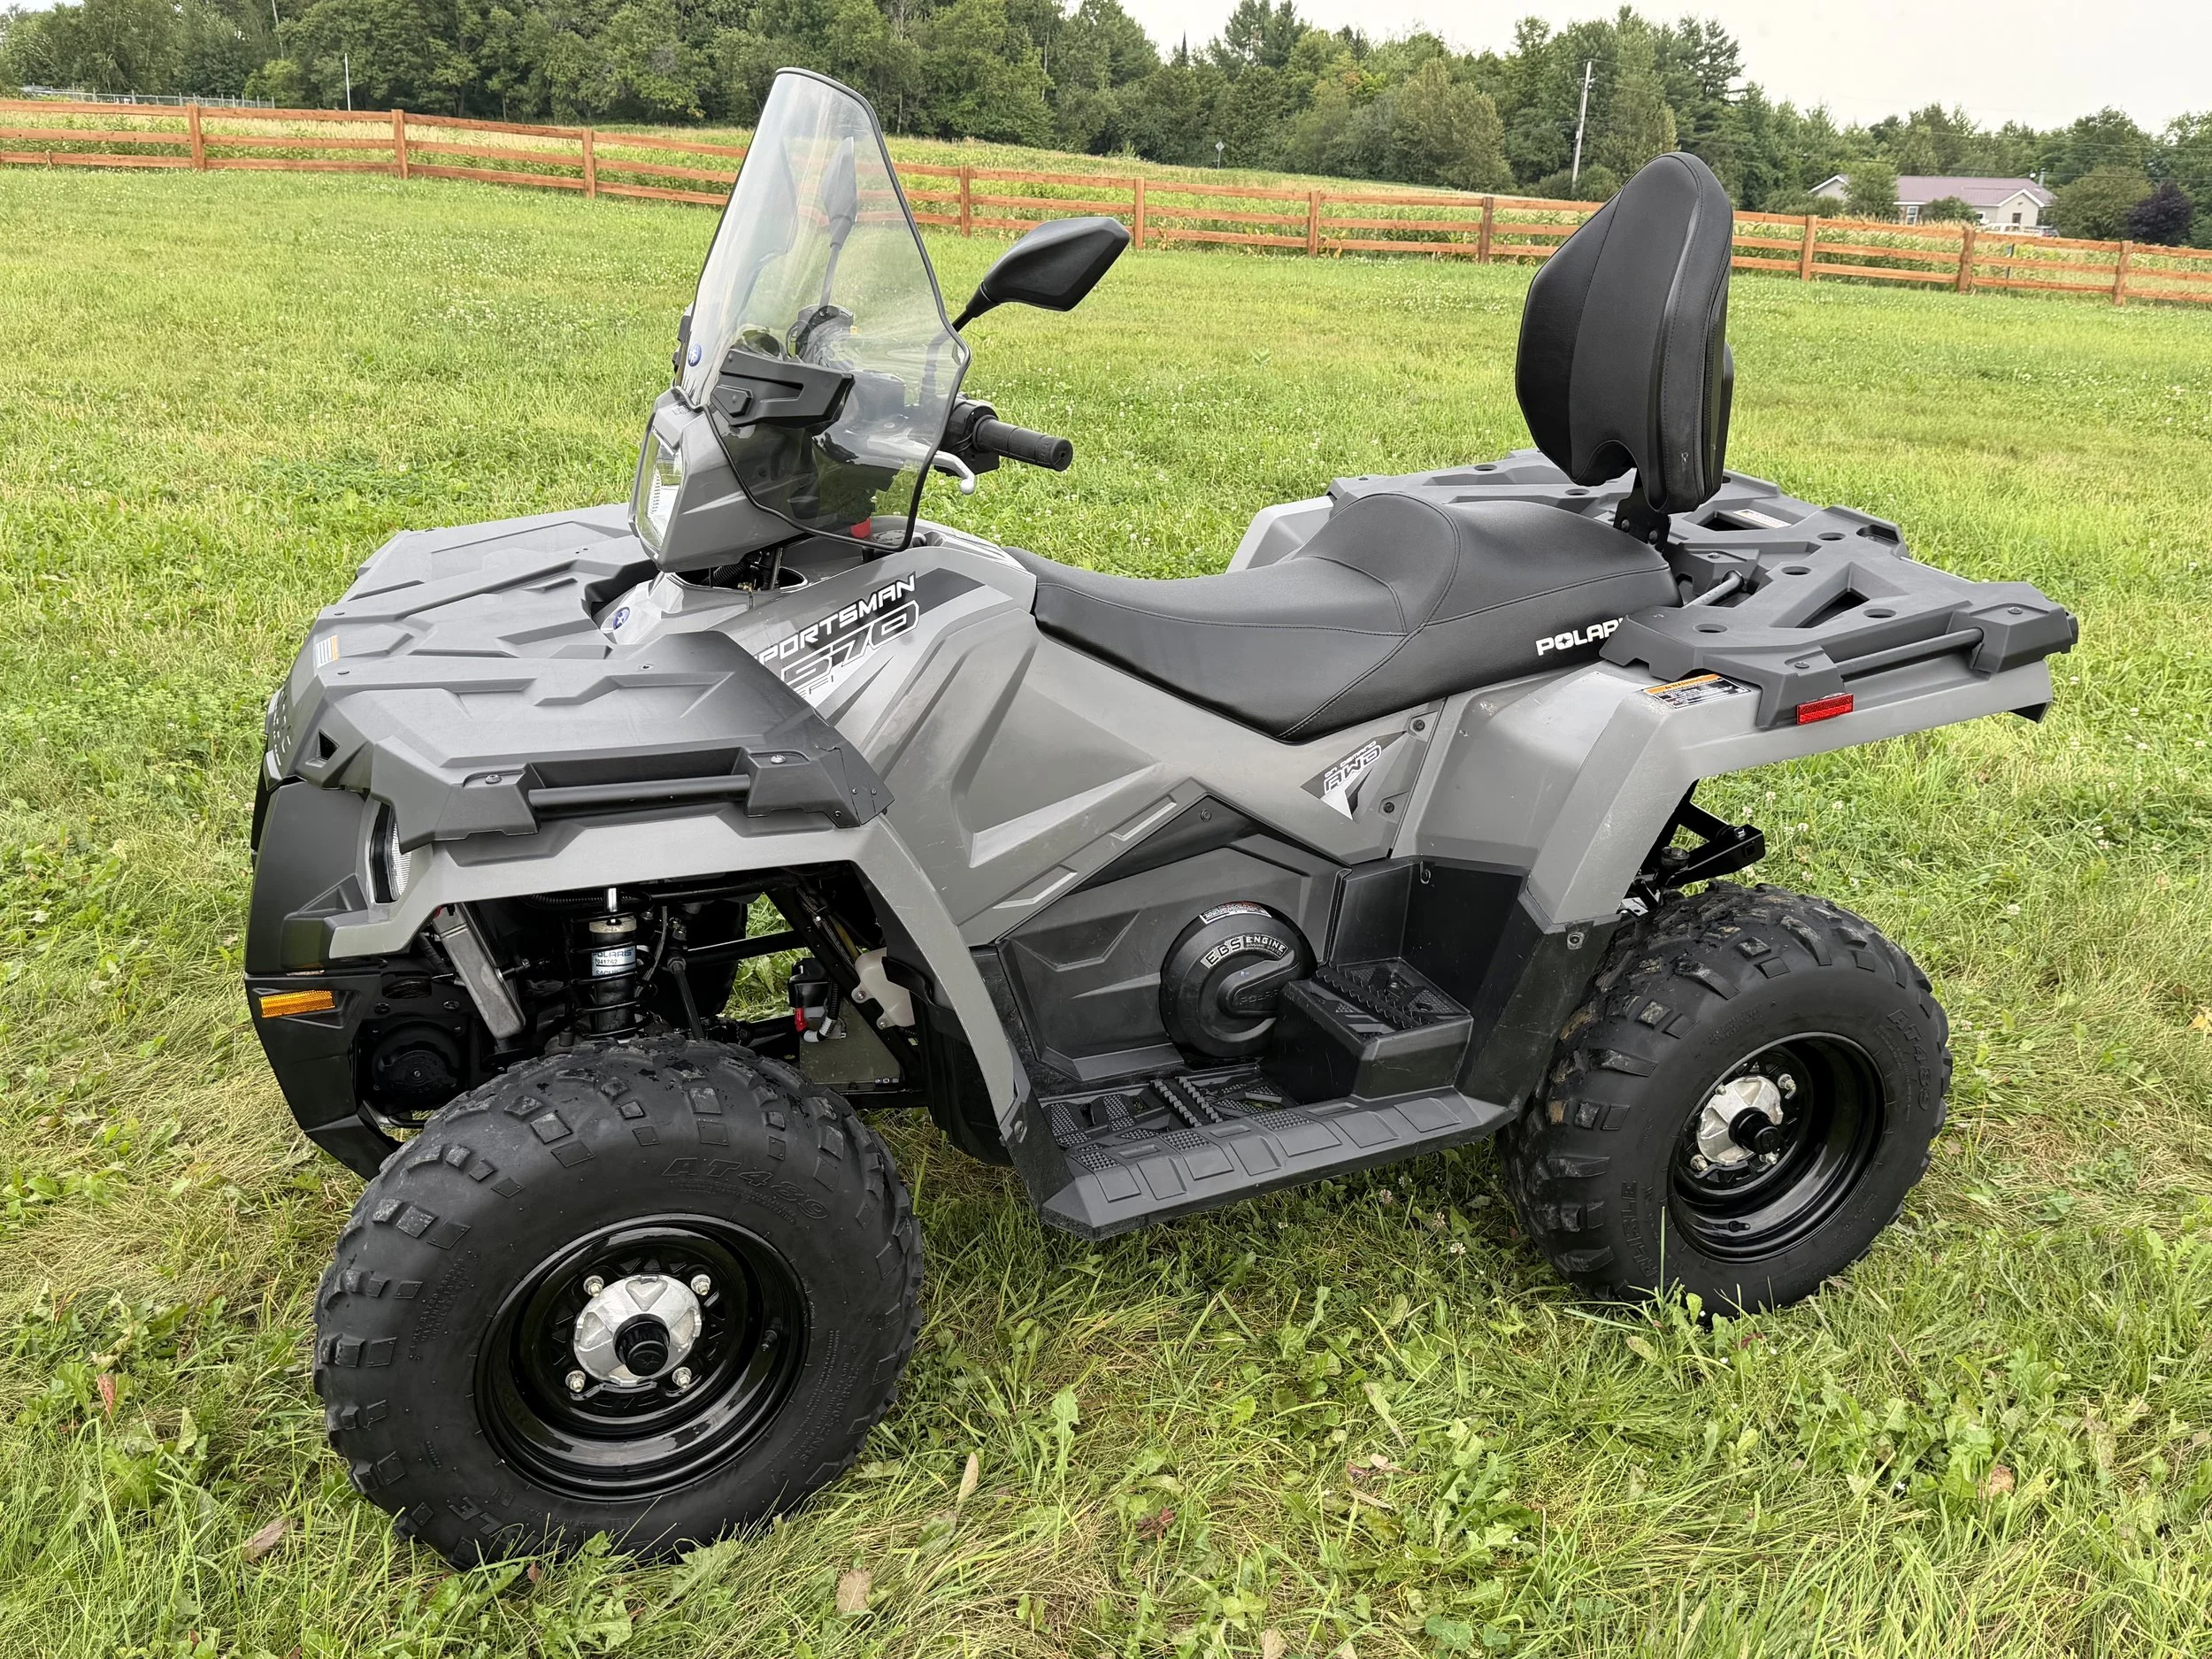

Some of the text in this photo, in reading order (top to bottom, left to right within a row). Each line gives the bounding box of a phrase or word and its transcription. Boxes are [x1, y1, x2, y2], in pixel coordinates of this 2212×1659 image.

[754, 575, 915, 665] PORTSMAN
[1535, 617, 1624, 657] POLAR
[780, 599, 920, 693] 570
[1323, 744, 1382, 795] AWD
[1205, 936, 1286, 965] EBS ENGINE
